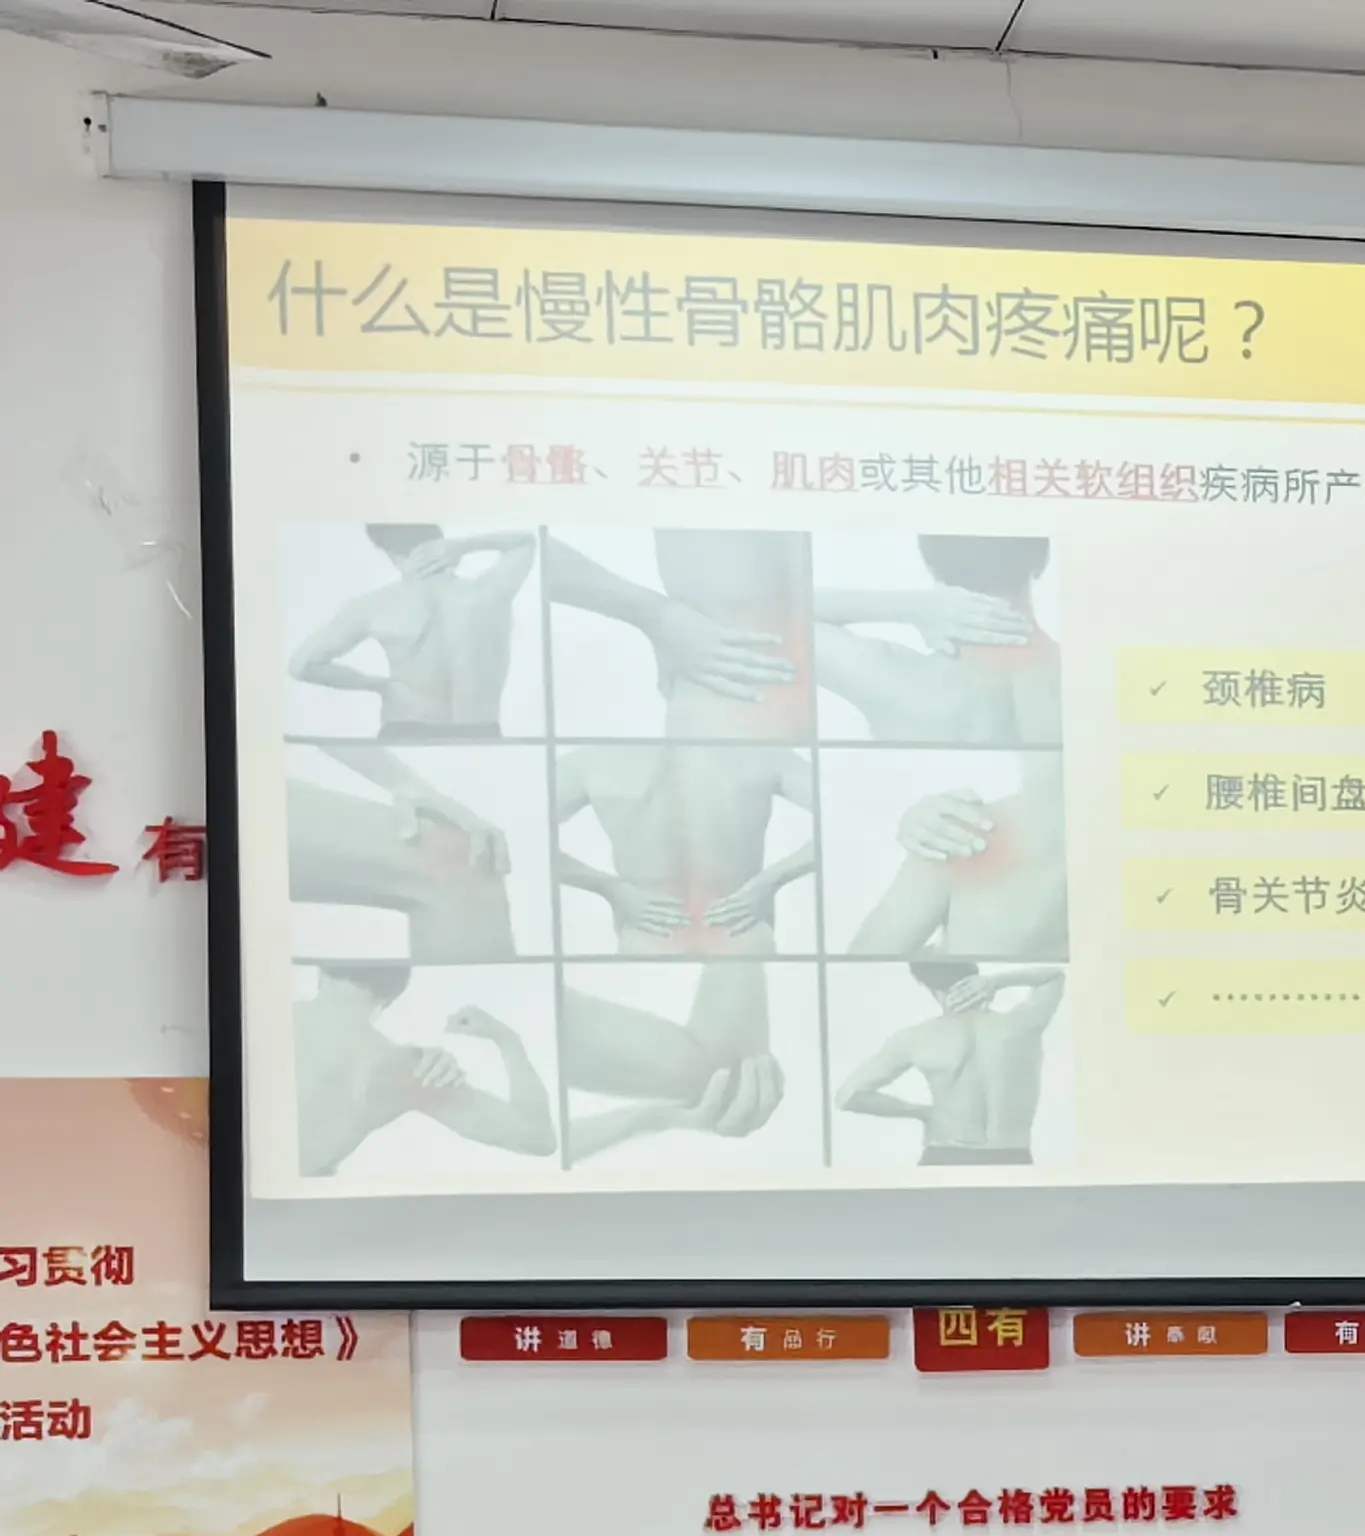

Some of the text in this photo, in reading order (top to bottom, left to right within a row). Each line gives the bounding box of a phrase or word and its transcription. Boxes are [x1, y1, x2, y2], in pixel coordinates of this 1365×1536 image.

[268, 260, 1265, 365] 什么是慢性骨骼肌肉疼痛呢？
[1202, 670, 1326, 710] 颈椎病
[0, 1246, 134, 1287] 习贯彻
[1, 1316, 359, 1363] 色社会主义思想》
[940, 1308, 1028, 1348] 四有
[0, 1400, 92, 1441] 活动
[703, 1484, 1239, 1533] 总书记对一个合格党员的要求
